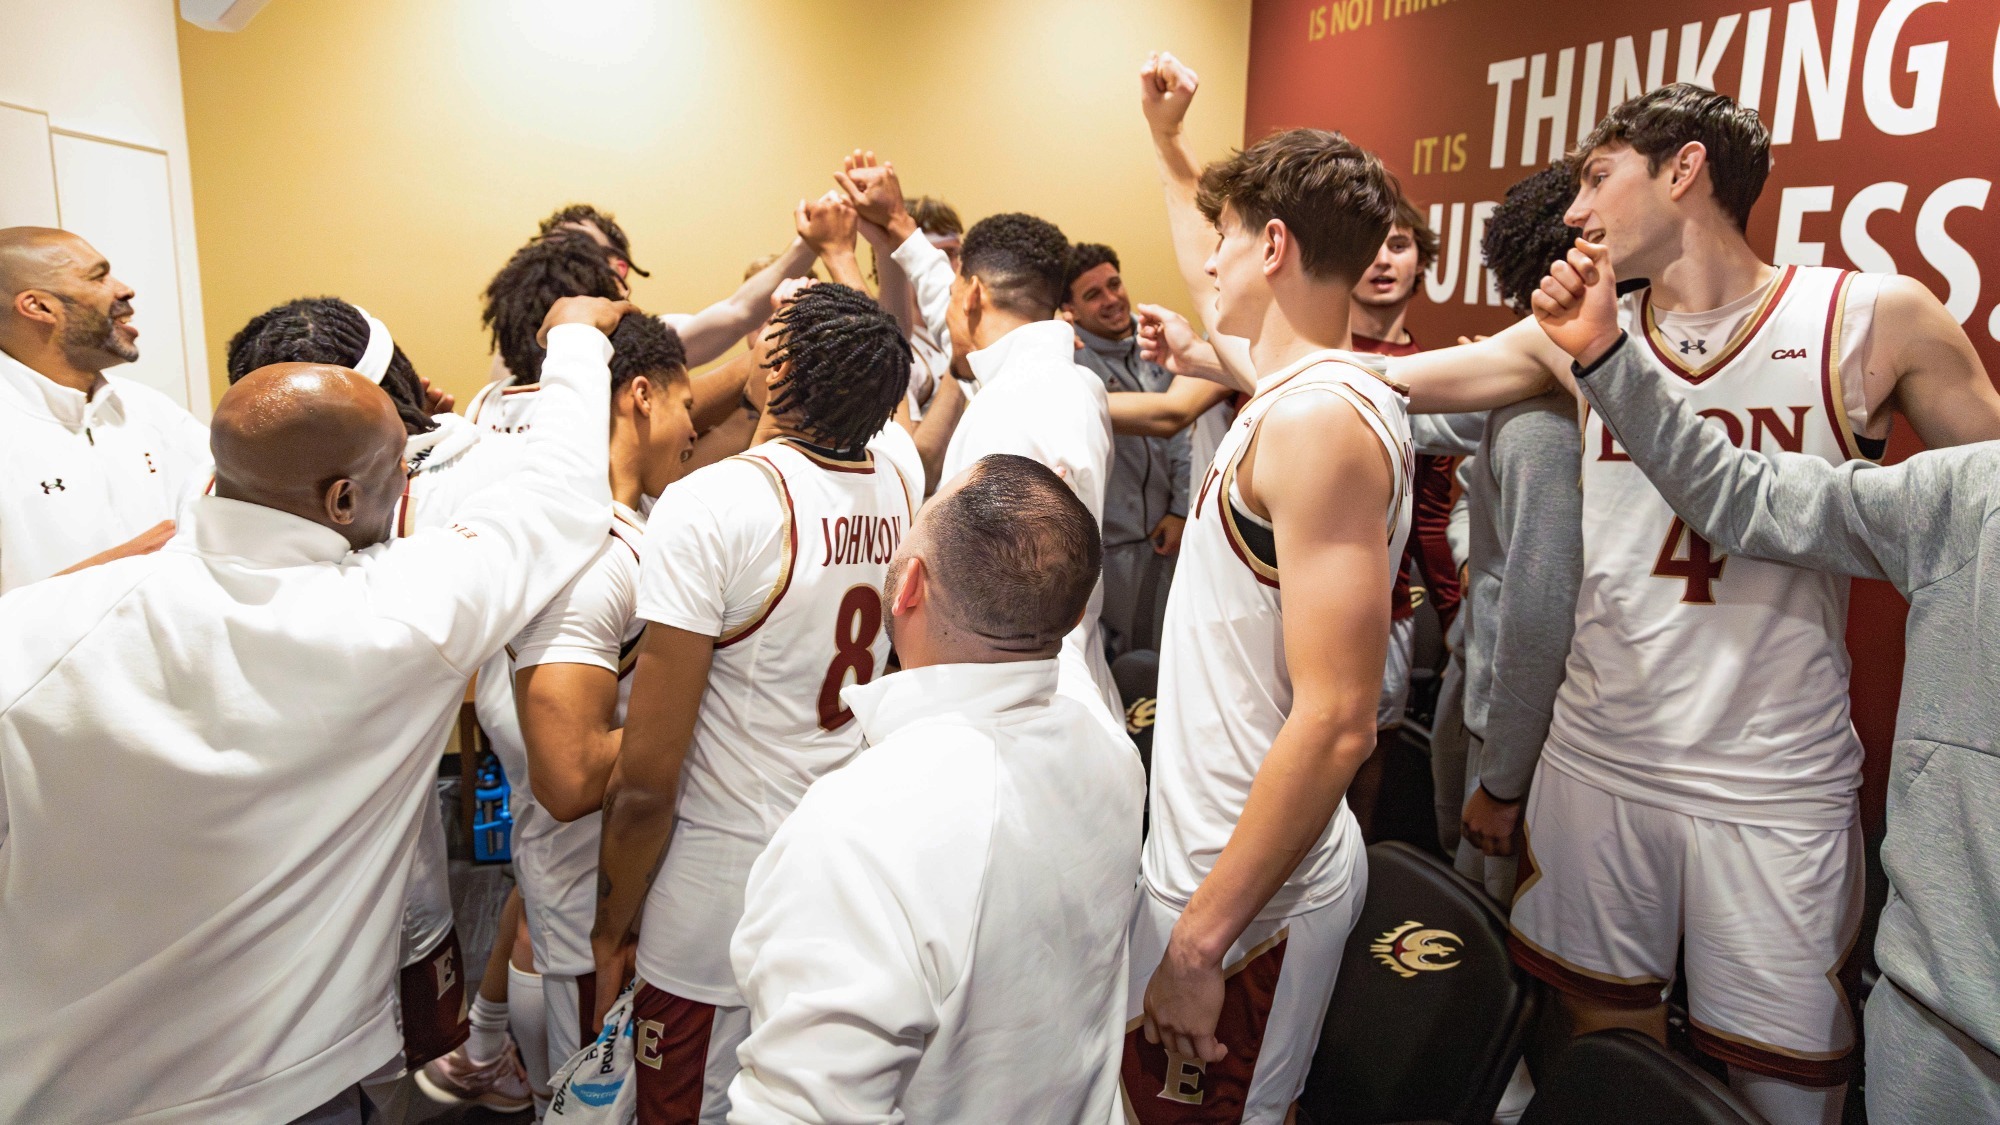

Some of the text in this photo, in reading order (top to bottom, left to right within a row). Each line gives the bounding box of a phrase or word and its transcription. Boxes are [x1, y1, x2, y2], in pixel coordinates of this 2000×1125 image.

[1309, 5, 1327, 41] IS
[1413, 132, 1467, 175] IT IS
[1771, 348, 1807, 360] CAA
[821, 514, 902, 567] JOHNSON
[1650, 514, 1728, 606] 4
[816, 582, 884, 732] 8
[636, 1017, 665, 1070] E
[1157, 1049, 1207, 1105] E
